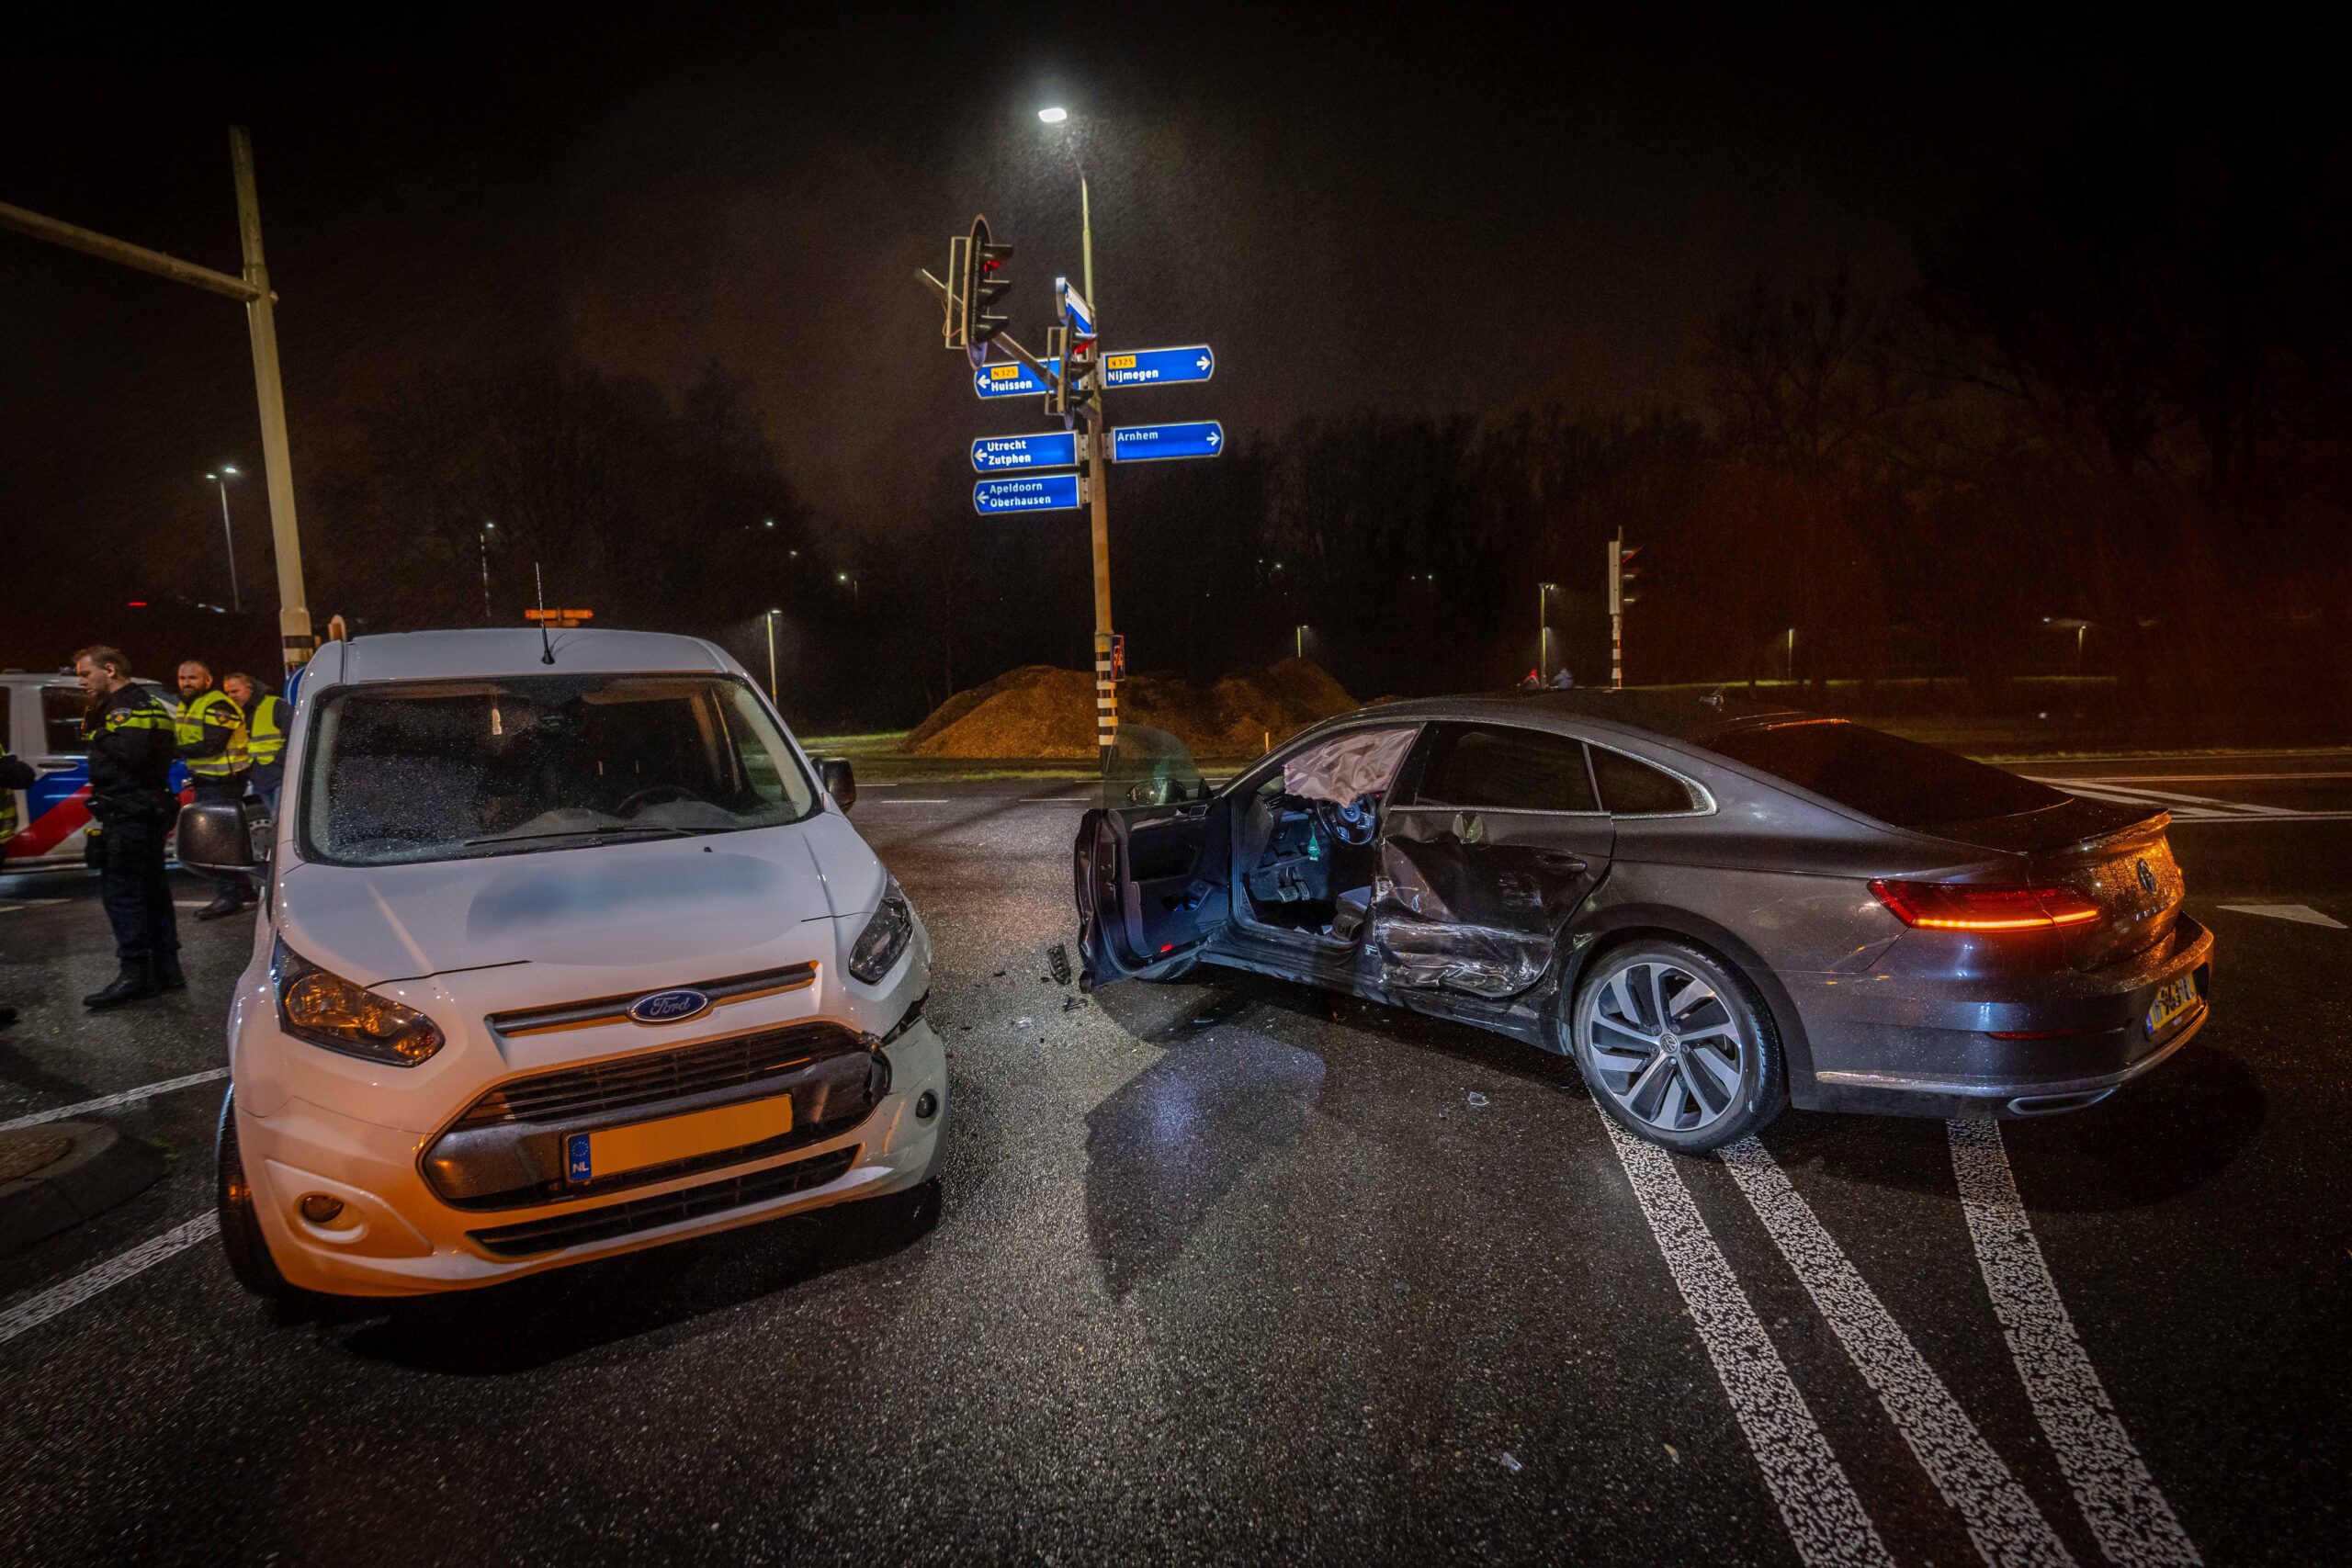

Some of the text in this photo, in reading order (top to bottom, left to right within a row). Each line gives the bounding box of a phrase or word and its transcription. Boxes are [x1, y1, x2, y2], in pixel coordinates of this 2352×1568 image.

[1107, 369, 1159, 383] Nijmegen
[991, 380, 1033, 392] Huissen
[1117, 431, 1159, 442] Arnhem
[987, 440, 1026, 453] Utrecht
[988, 454, 1032, 467] Zutphen
[989, 482, 1043, 495] Apeldoorn
[989, 496, 1051, 508] Oberhausen
[650, 995, 691, 1016] Ford
[572, 1161, 590, 1173] NL
